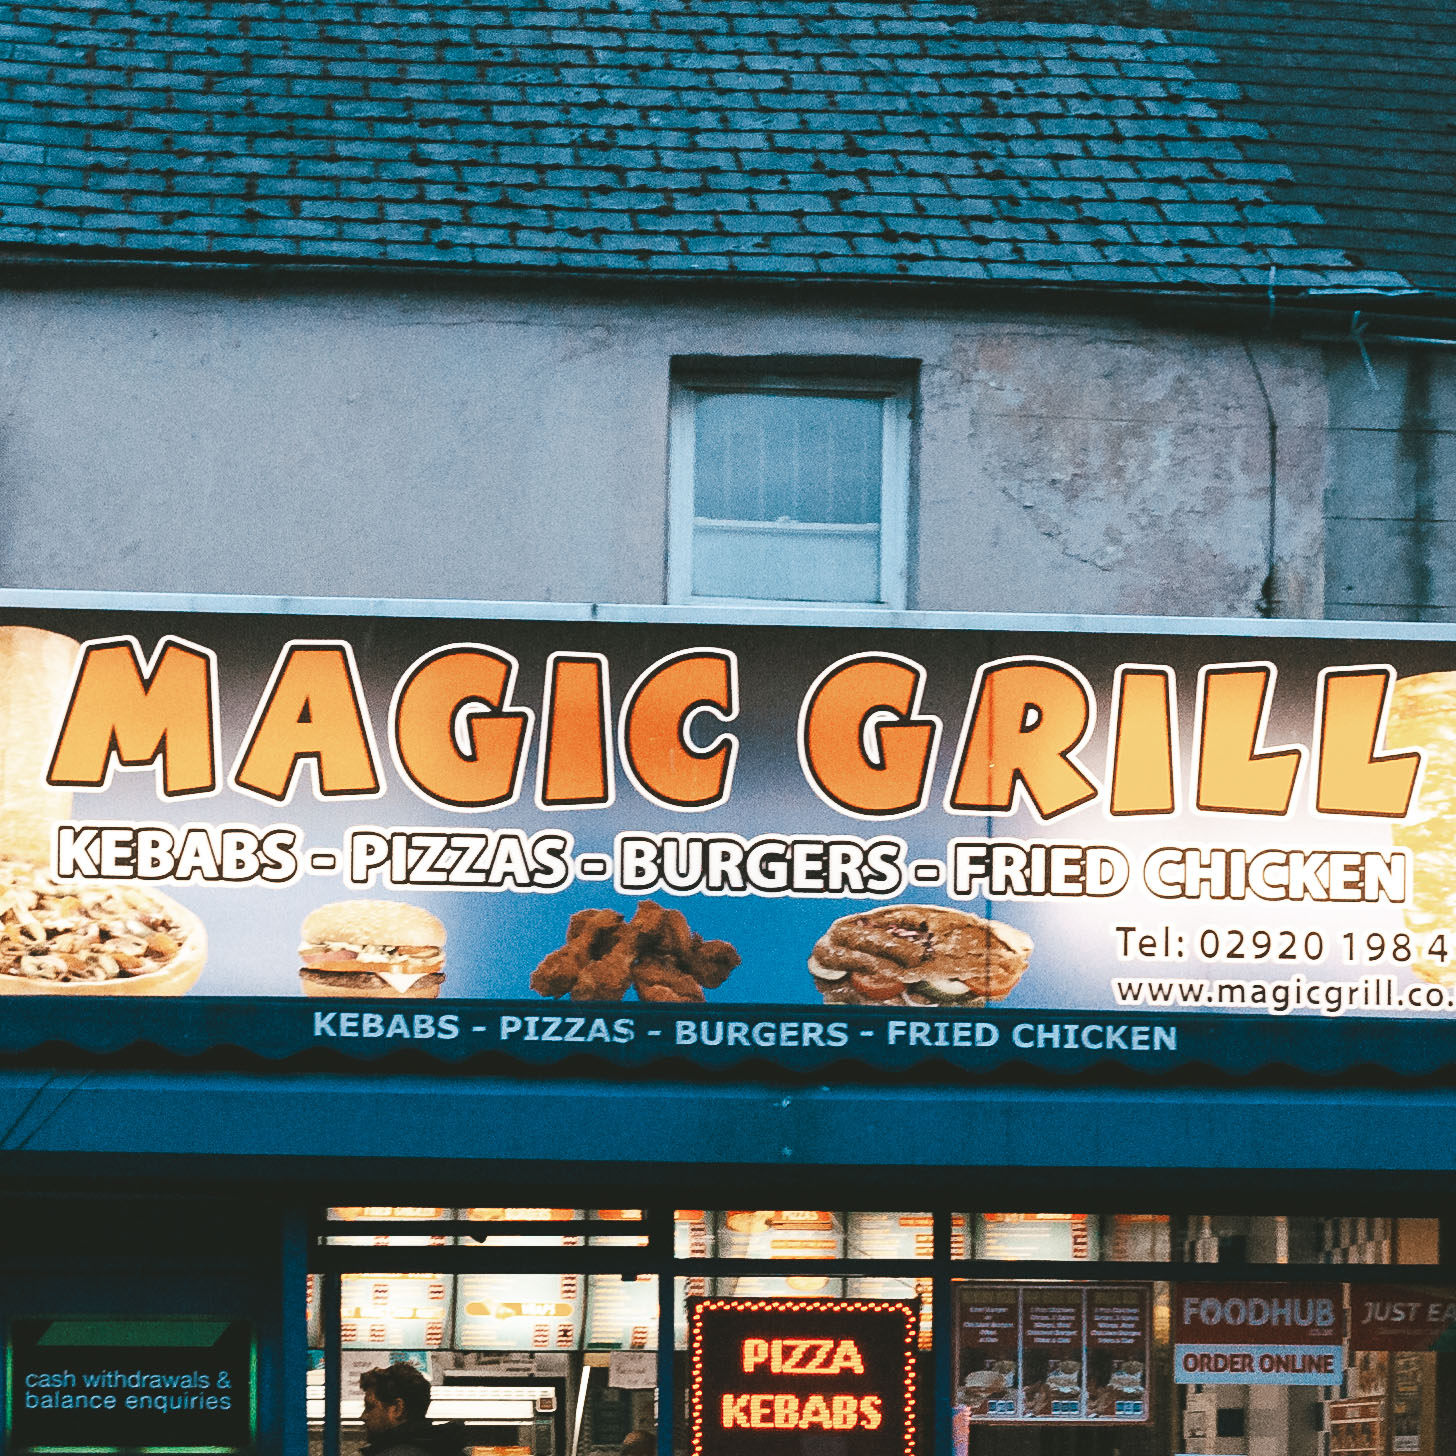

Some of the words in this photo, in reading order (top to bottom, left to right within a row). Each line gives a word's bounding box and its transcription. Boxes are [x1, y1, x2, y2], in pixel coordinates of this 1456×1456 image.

[45, 635, 741, 811] MAGIC
[798, 649, 1425, 821] GRILL
[53, 823, 304, 885] KEBABS
[348, 828, 572, 891] PIZZAS
[614, 833, 907, 899] BURGERS
[948, 838, 1132, 902] FRIED
[1140, 843, 1411, 906] CHICKEN
[1116, 926, 1186, 960] Tel:
[1200, 930, 1326, 962] 02920
[1342, 931, 1415, 964] 198
[313, 1011, 459, 1041] KEBABS
[501, 1014, 635, 1044] PIZZAS
[677, 1018, 849, 1048] BURGERS
[888, 1020, 999, 1048] FRIED
[1012, 1023, 1177, 1052] CHICKEN
[1183, 1297, 1335, 1327] FOODHUB
[1360, 1301, 1421, 1324] JUST
[743, 1338, 865, 1375] PIZZA
[1182, 1353, 1254, 1374] ORDER
[1258, 1353, 1335, 1375] ONLINE
[25, 1369, 76, 1388] cash
[82, 1369, 210, 1389] withdrawals
[216, 1370, 232, 1389] &
[25, 1390, 117, 1409] balance
[125, 1391, 232, 1413] enquiries
[722, 1393, 883, 1430] KEBABS
